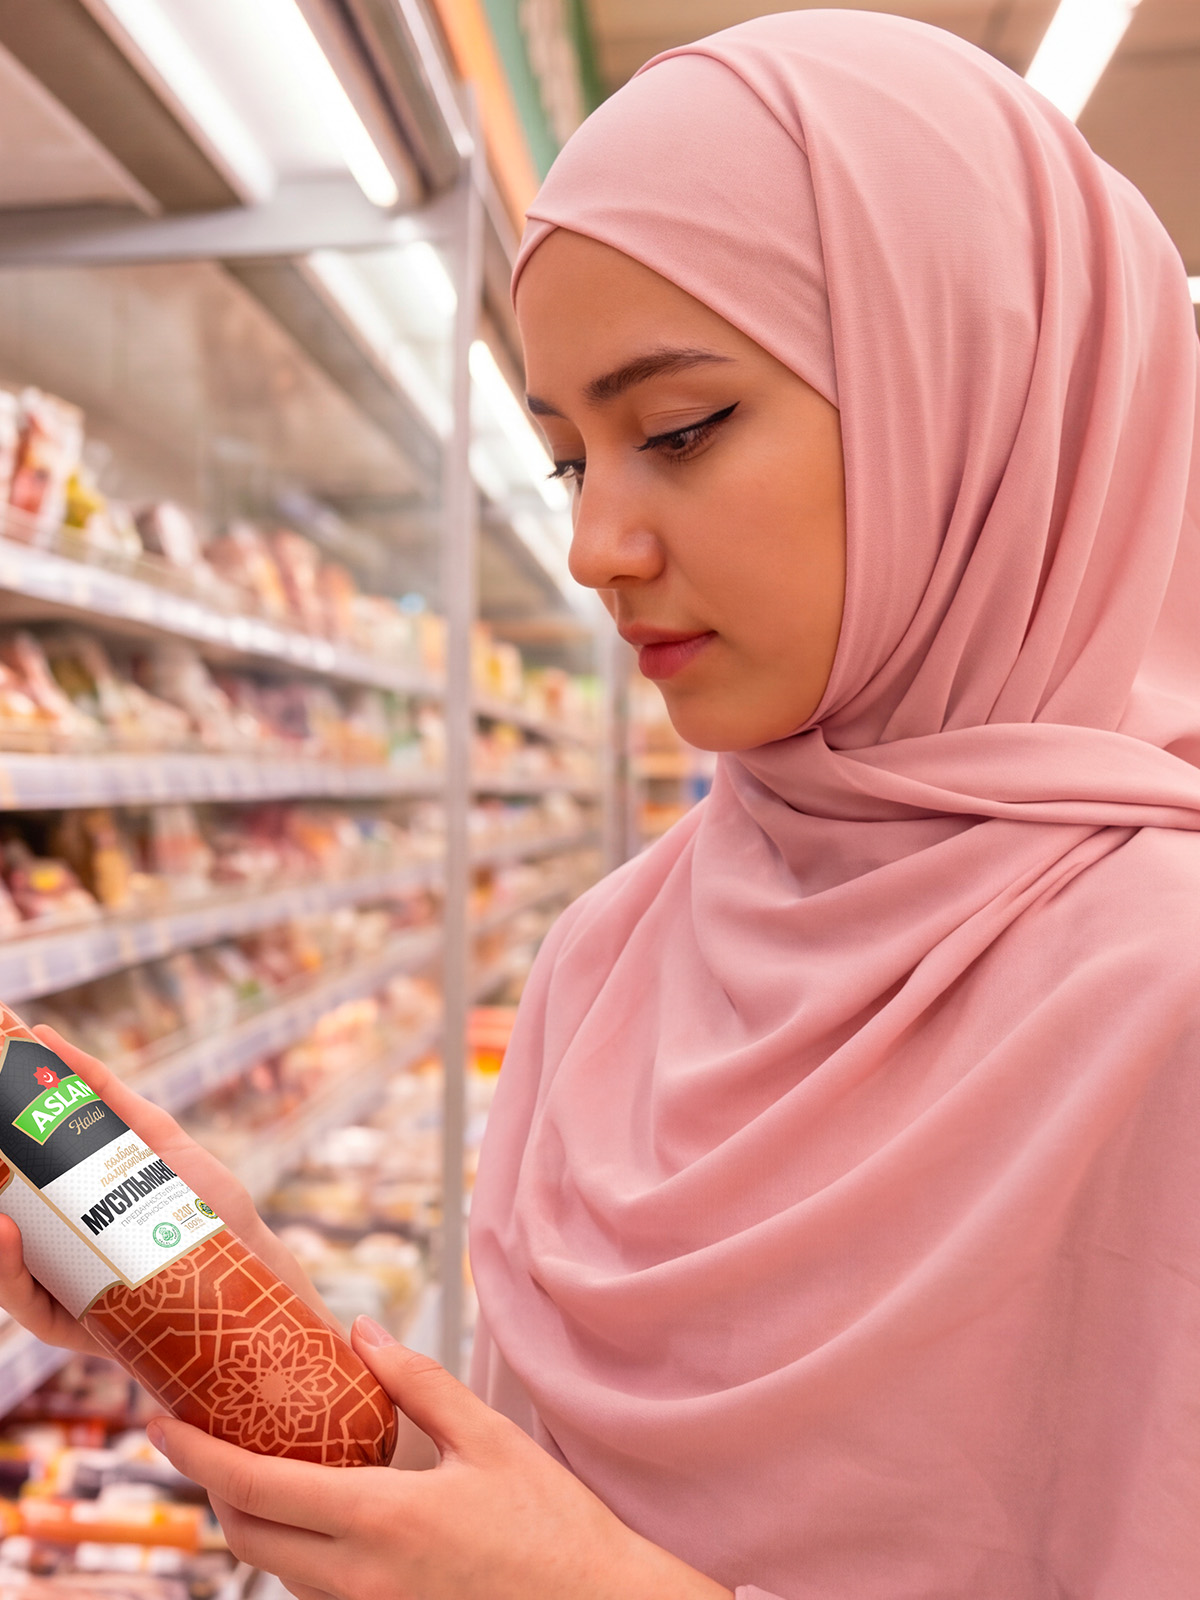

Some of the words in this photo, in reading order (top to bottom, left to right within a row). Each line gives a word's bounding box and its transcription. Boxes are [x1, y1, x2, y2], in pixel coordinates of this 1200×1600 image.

[68, 1106, 105, 1135] Halal
[103, 1143, 140, 1170] колбаса
[184, 1217, 204, 1231] 100%
